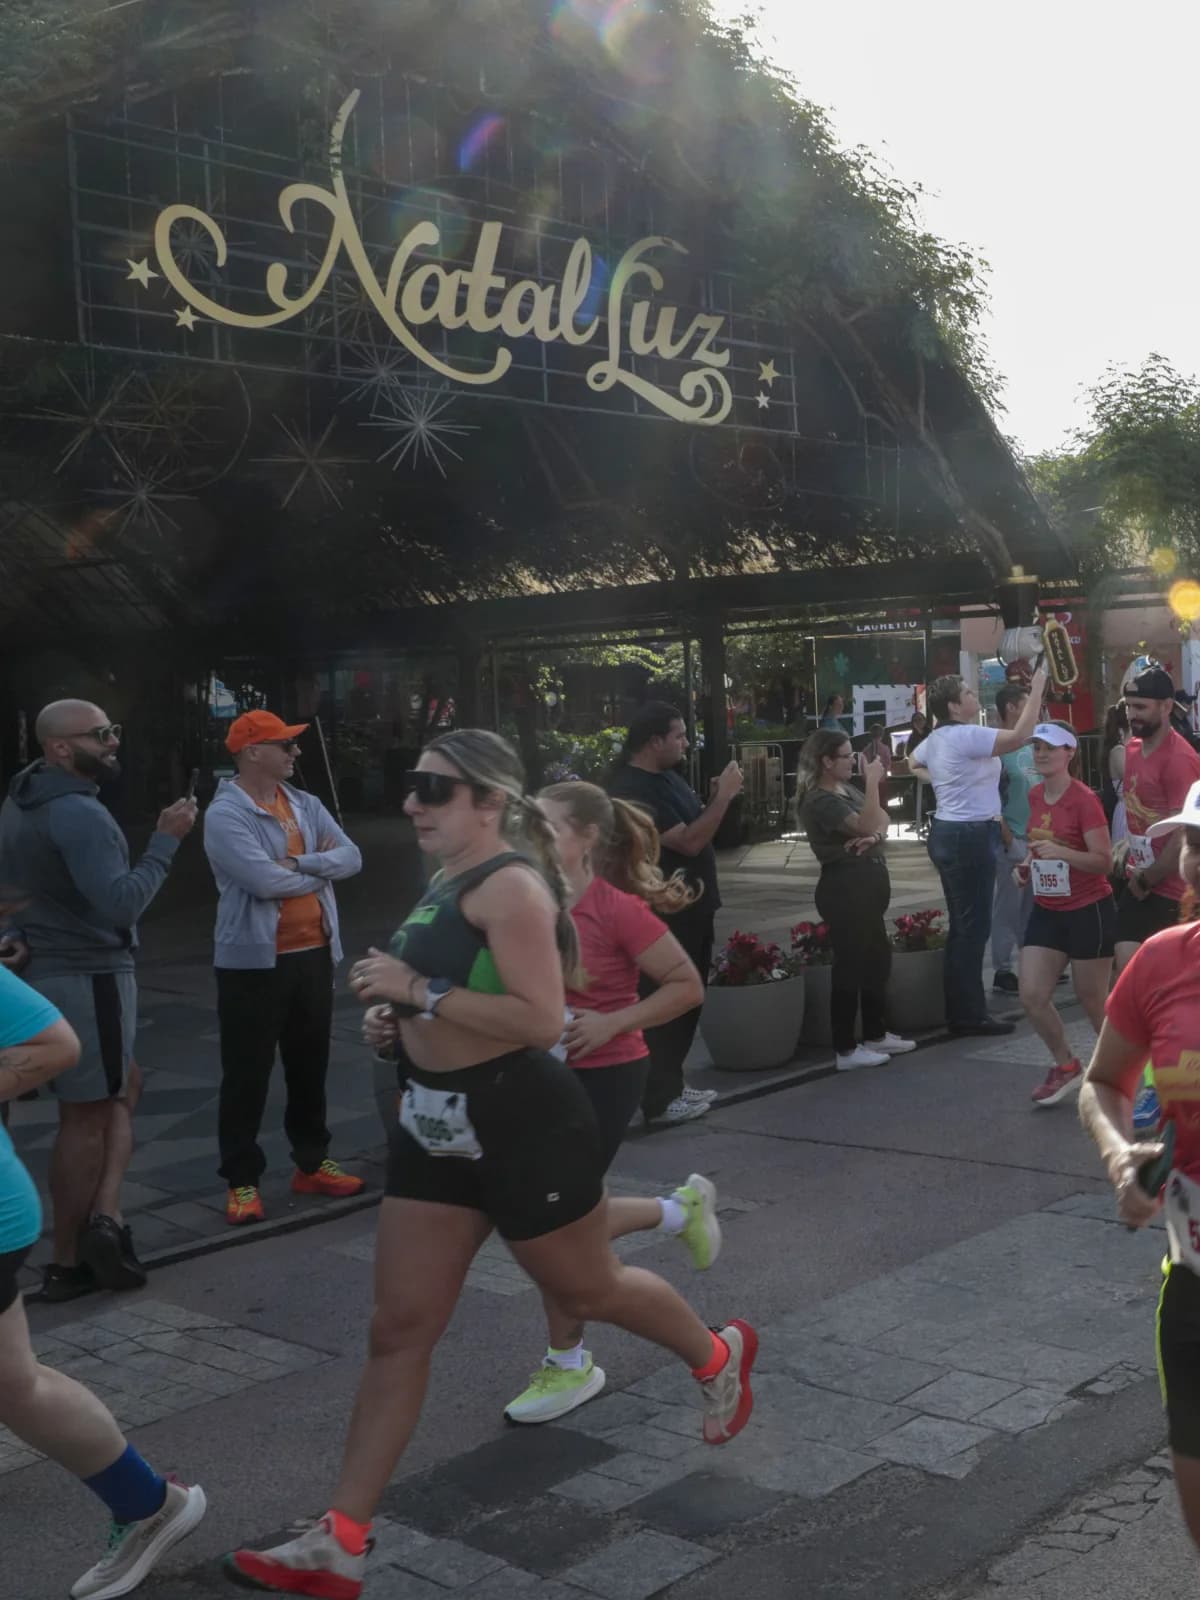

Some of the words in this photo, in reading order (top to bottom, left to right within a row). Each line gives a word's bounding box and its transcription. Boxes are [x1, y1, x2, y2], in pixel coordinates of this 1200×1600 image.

[154, 88, 600, 385] Natal
[586, 235, 733, 426] Luz
[1039, 873, 1058, 888] 5155
